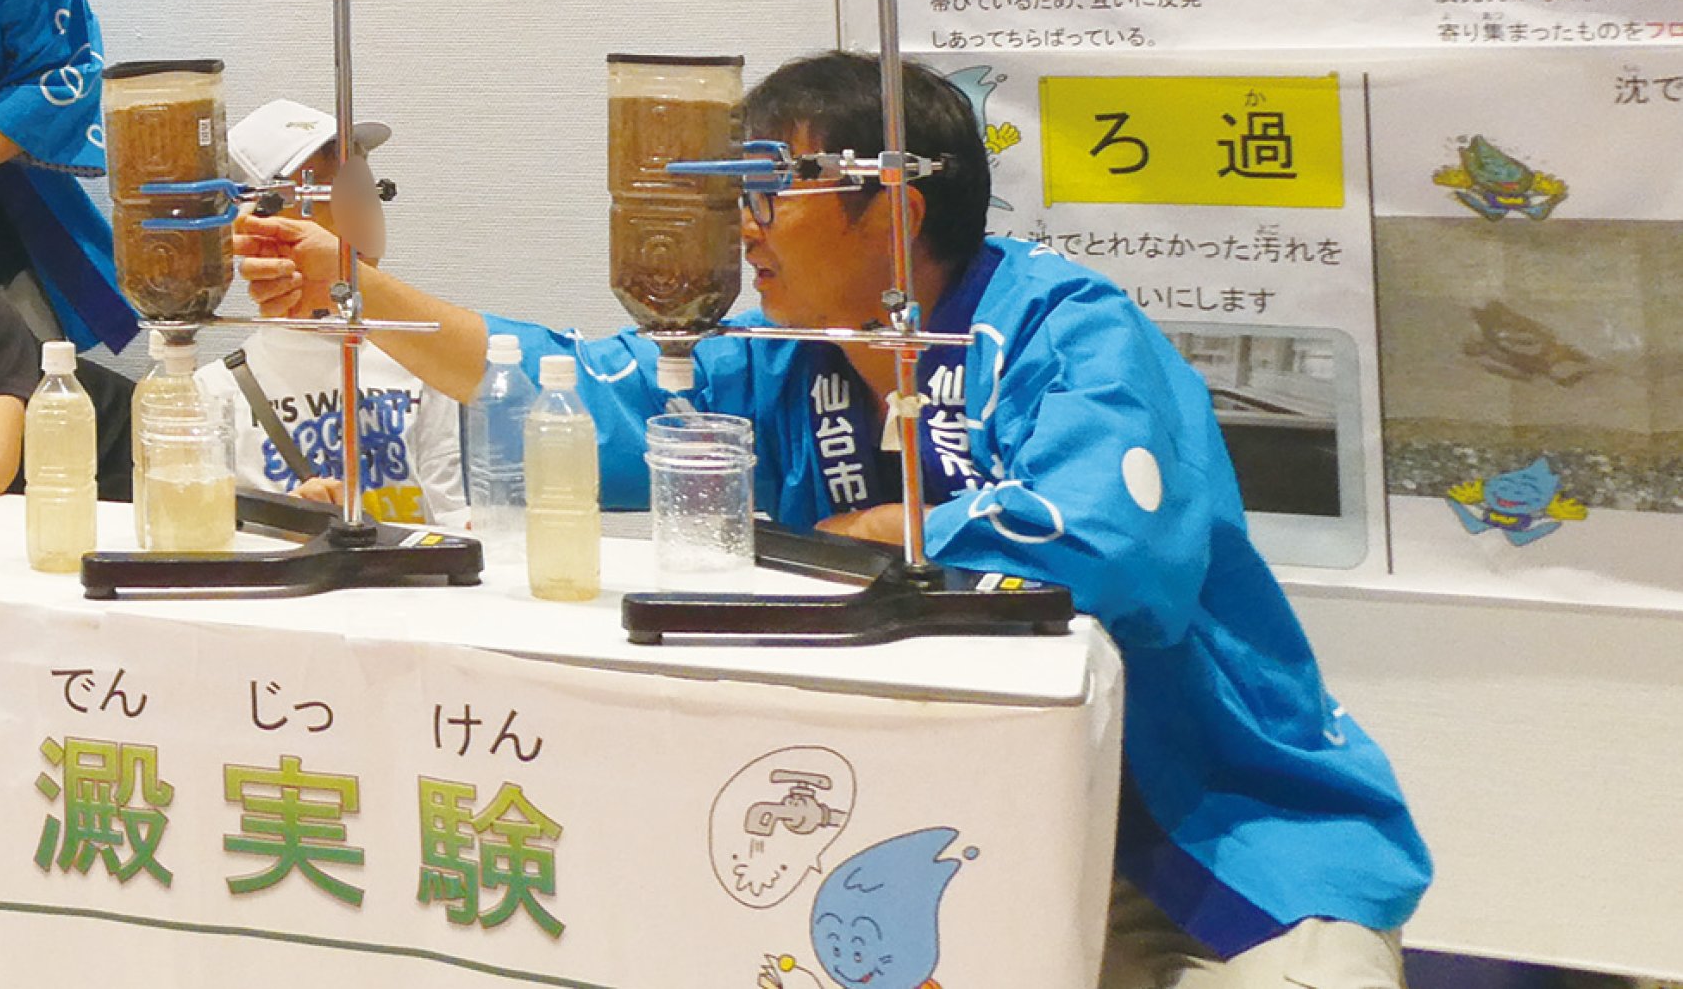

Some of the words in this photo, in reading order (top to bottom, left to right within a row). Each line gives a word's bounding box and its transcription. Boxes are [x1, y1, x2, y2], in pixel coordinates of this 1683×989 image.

[931, 26, 1157, 50] しあってちらばっている。
[1245, 88, 1266, 107] か
[1088, 110, 1299, 179] ろ過
[1122, 285, 1276, 314] いにします
[51, 667, 149, 719] でん
[249, 679, 335, 733] じっ
[432, 702, 544, 763] けん
